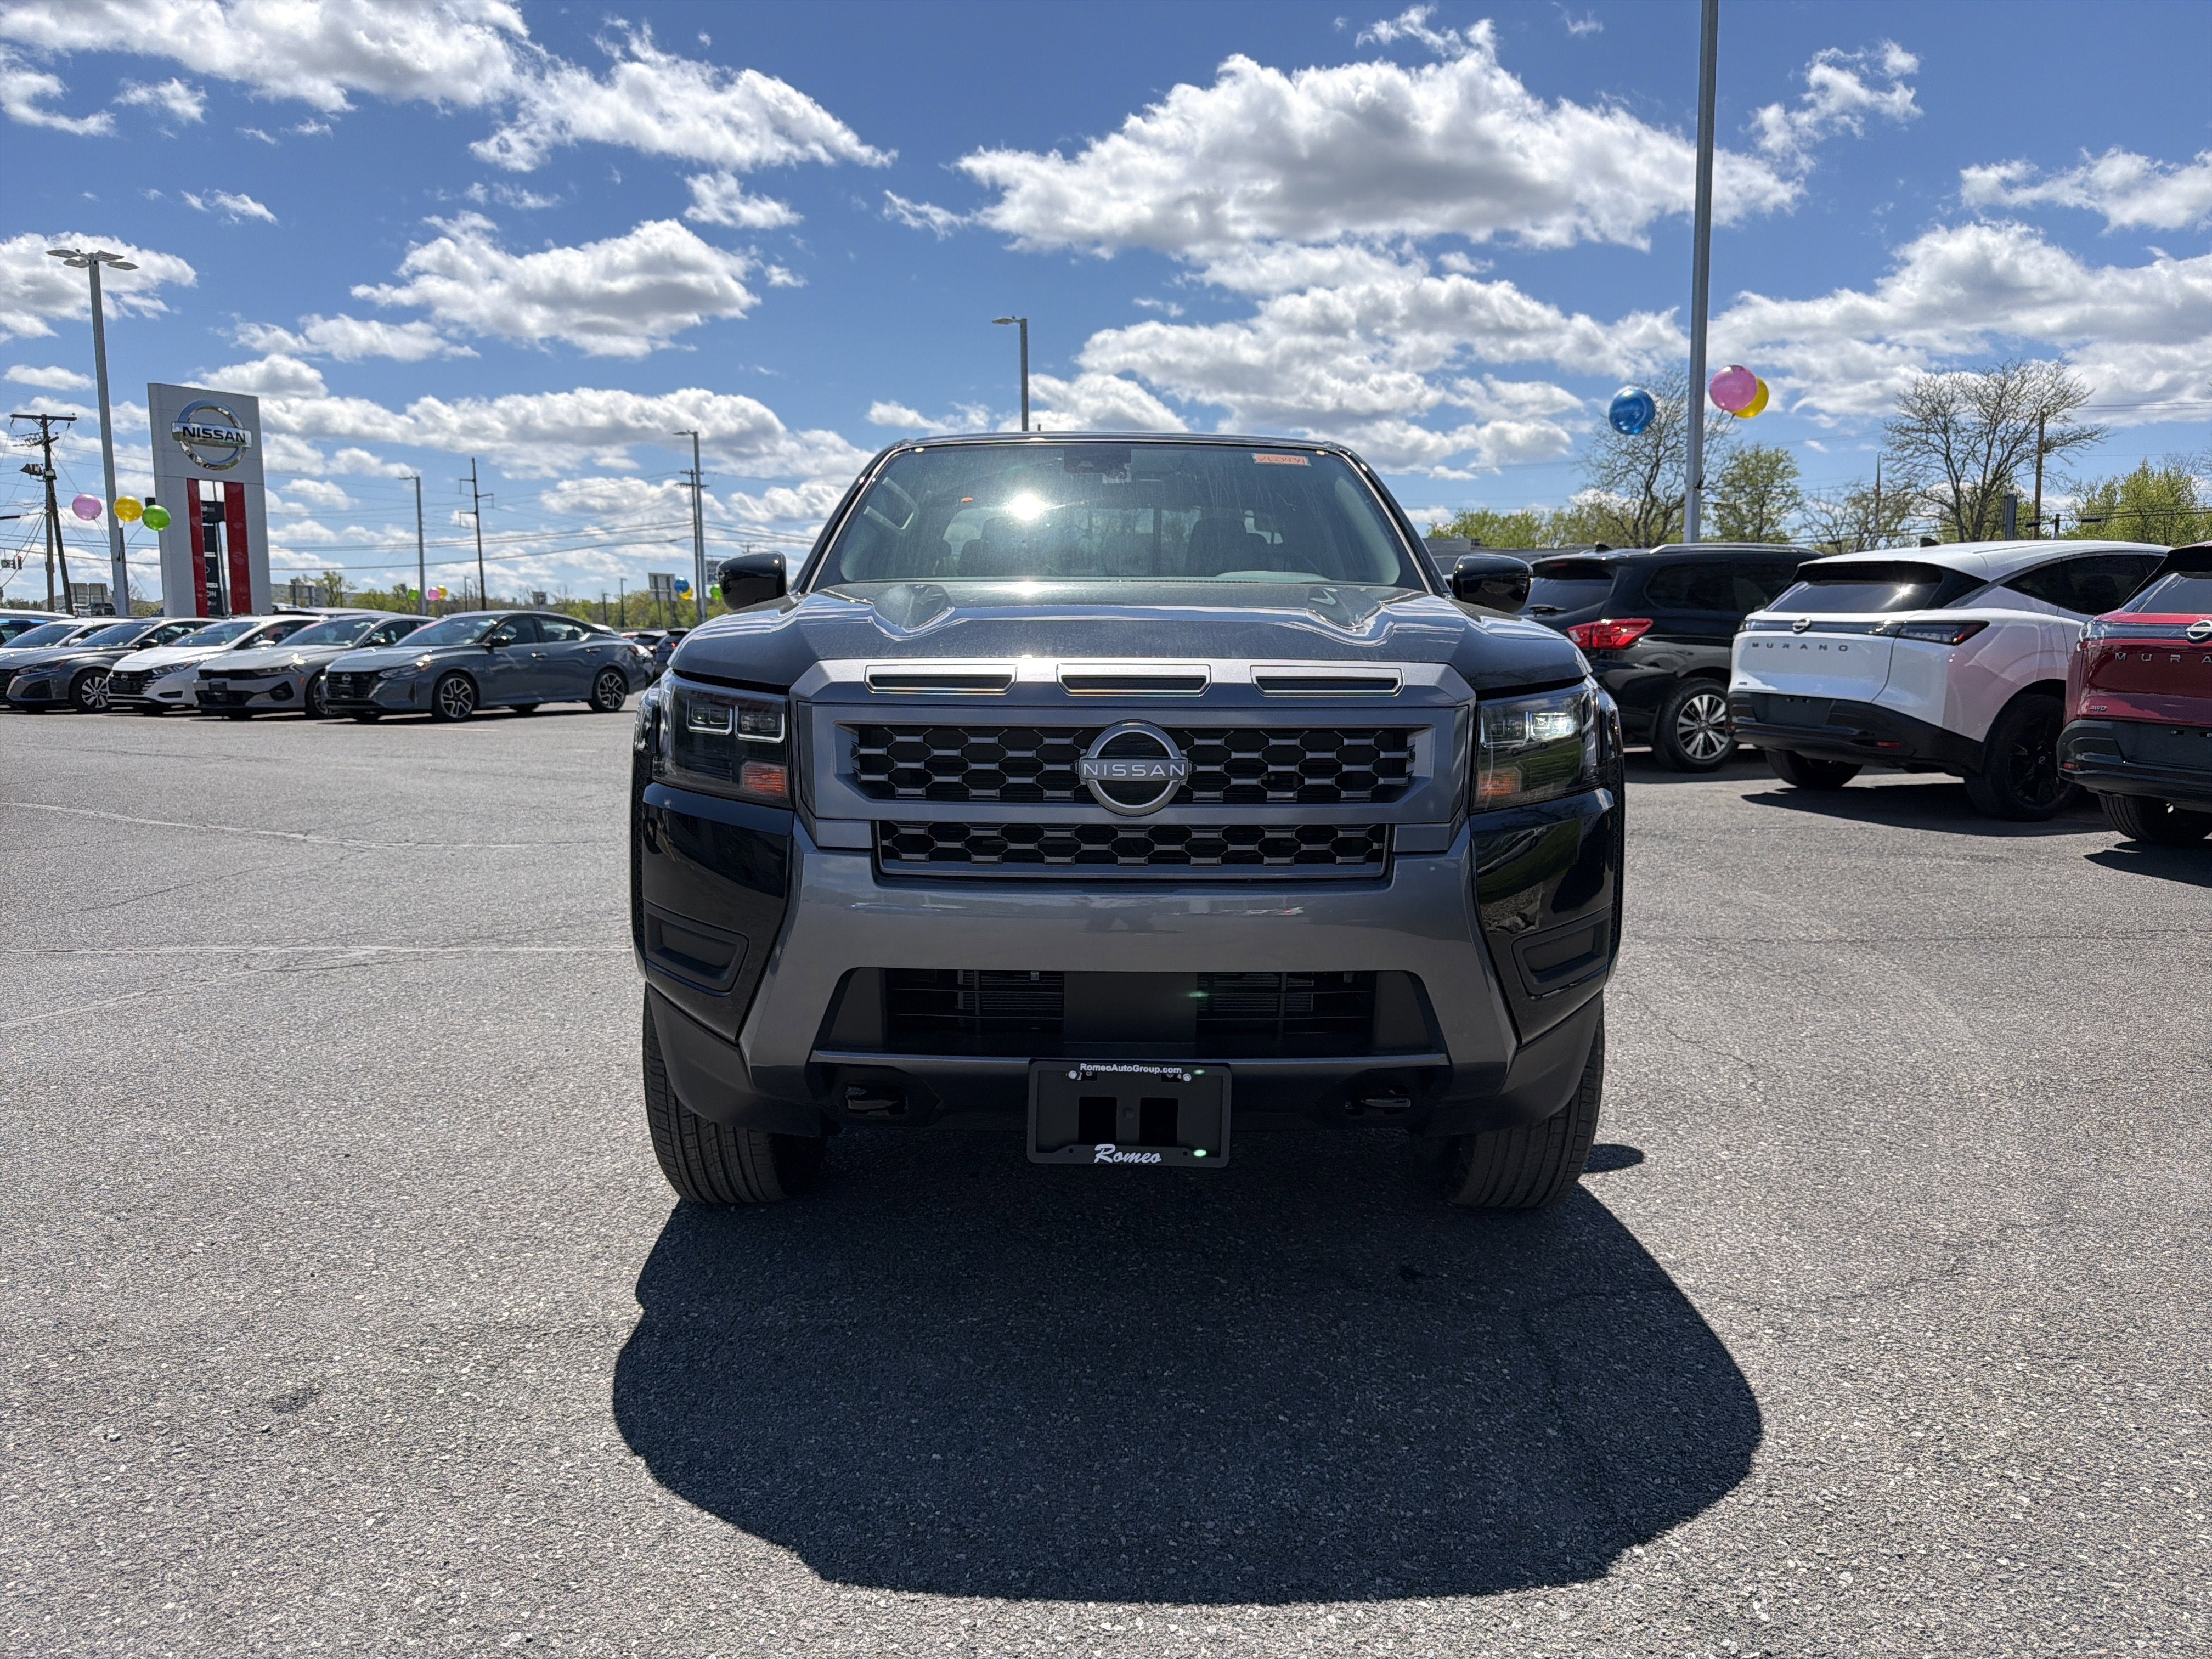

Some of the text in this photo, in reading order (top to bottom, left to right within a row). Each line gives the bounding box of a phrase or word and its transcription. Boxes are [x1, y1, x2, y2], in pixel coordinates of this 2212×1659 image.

[182, 426, 246, 443] NISSAN
[1752, 642, 1848, 652] MURANO
[1084, 763, 1184, 777] NISSAN
[1080, 1063, 1182, 1074] RomeoAutoGroup.com
[1093, 1143, 1162, 1164] Romeo
